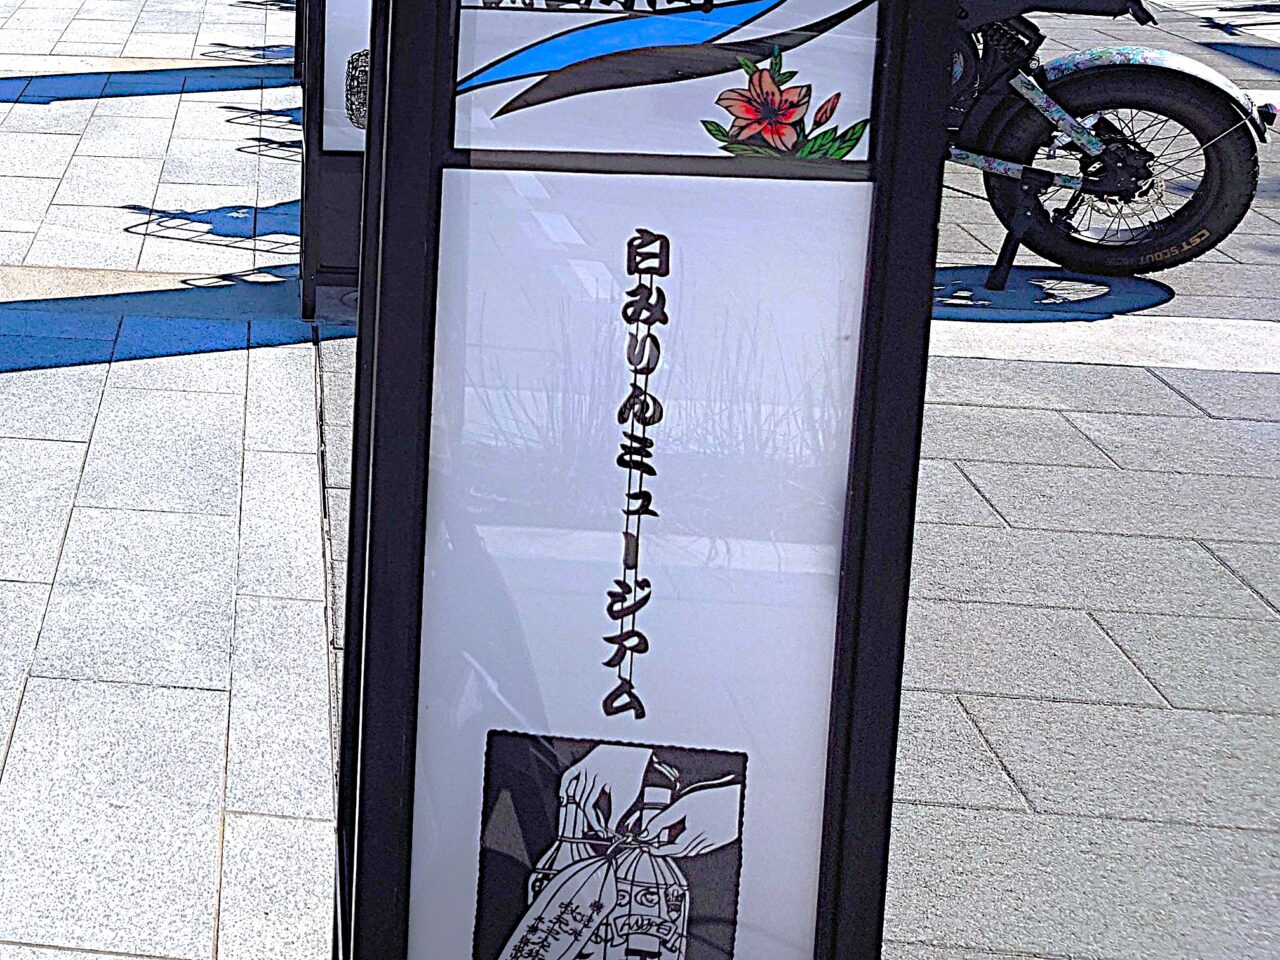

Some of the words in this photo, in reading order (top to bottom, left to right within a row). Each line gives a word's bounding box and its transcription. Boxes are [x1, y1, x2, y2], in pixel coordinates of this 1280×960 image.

[1182, 228, 1211, 252] CST
[601, 227, 671, 721] 白みりんミュージアム
